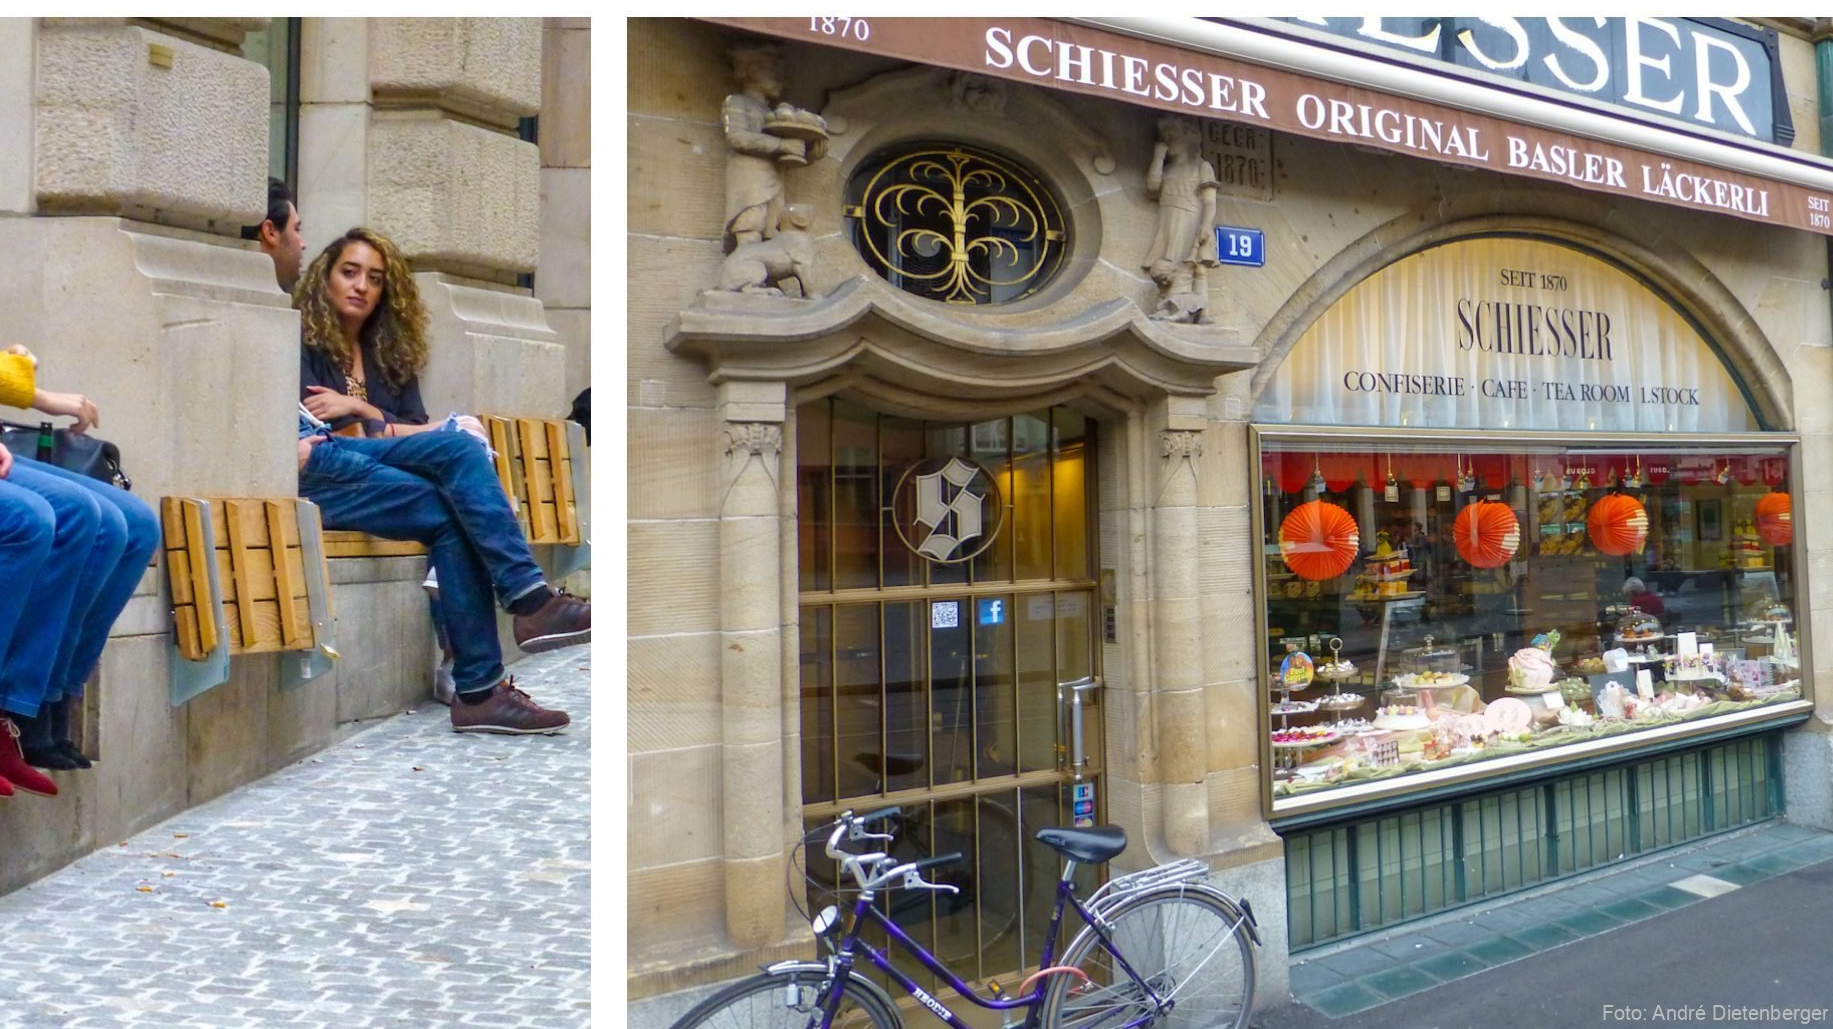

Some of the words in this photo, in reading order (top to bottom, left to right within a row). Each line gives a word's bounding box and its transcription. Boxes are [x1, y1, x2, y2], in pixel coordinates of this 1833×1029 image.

[809, 17, 870, 41] 1870
[983, 26, 1271, 120] SCHIESSER
[1295, 93, 1489, 162] ORIGINAL
[1507, 136, 1628, 189] BASLER
[1640, 162, 1770, 217] LÄCKERLI
[1807, 195, 1829, 212] SEIT
[1809, 213, 1831, 229] 1870
[1229, 233, 1253, 258] 19
[1500, 268, 1536, 288] SEIT
[1540, 274, 1568, 292] 1870
[1456, 297, 1615, 362] SCHIESSER
[1343, 371, 1465, 397] CONFISERIE
[1482, 378, 1528, 400] CAFE
[1541, 381, 1575, 402] TEA
[1580, 384, 1631, 404] ROOM
